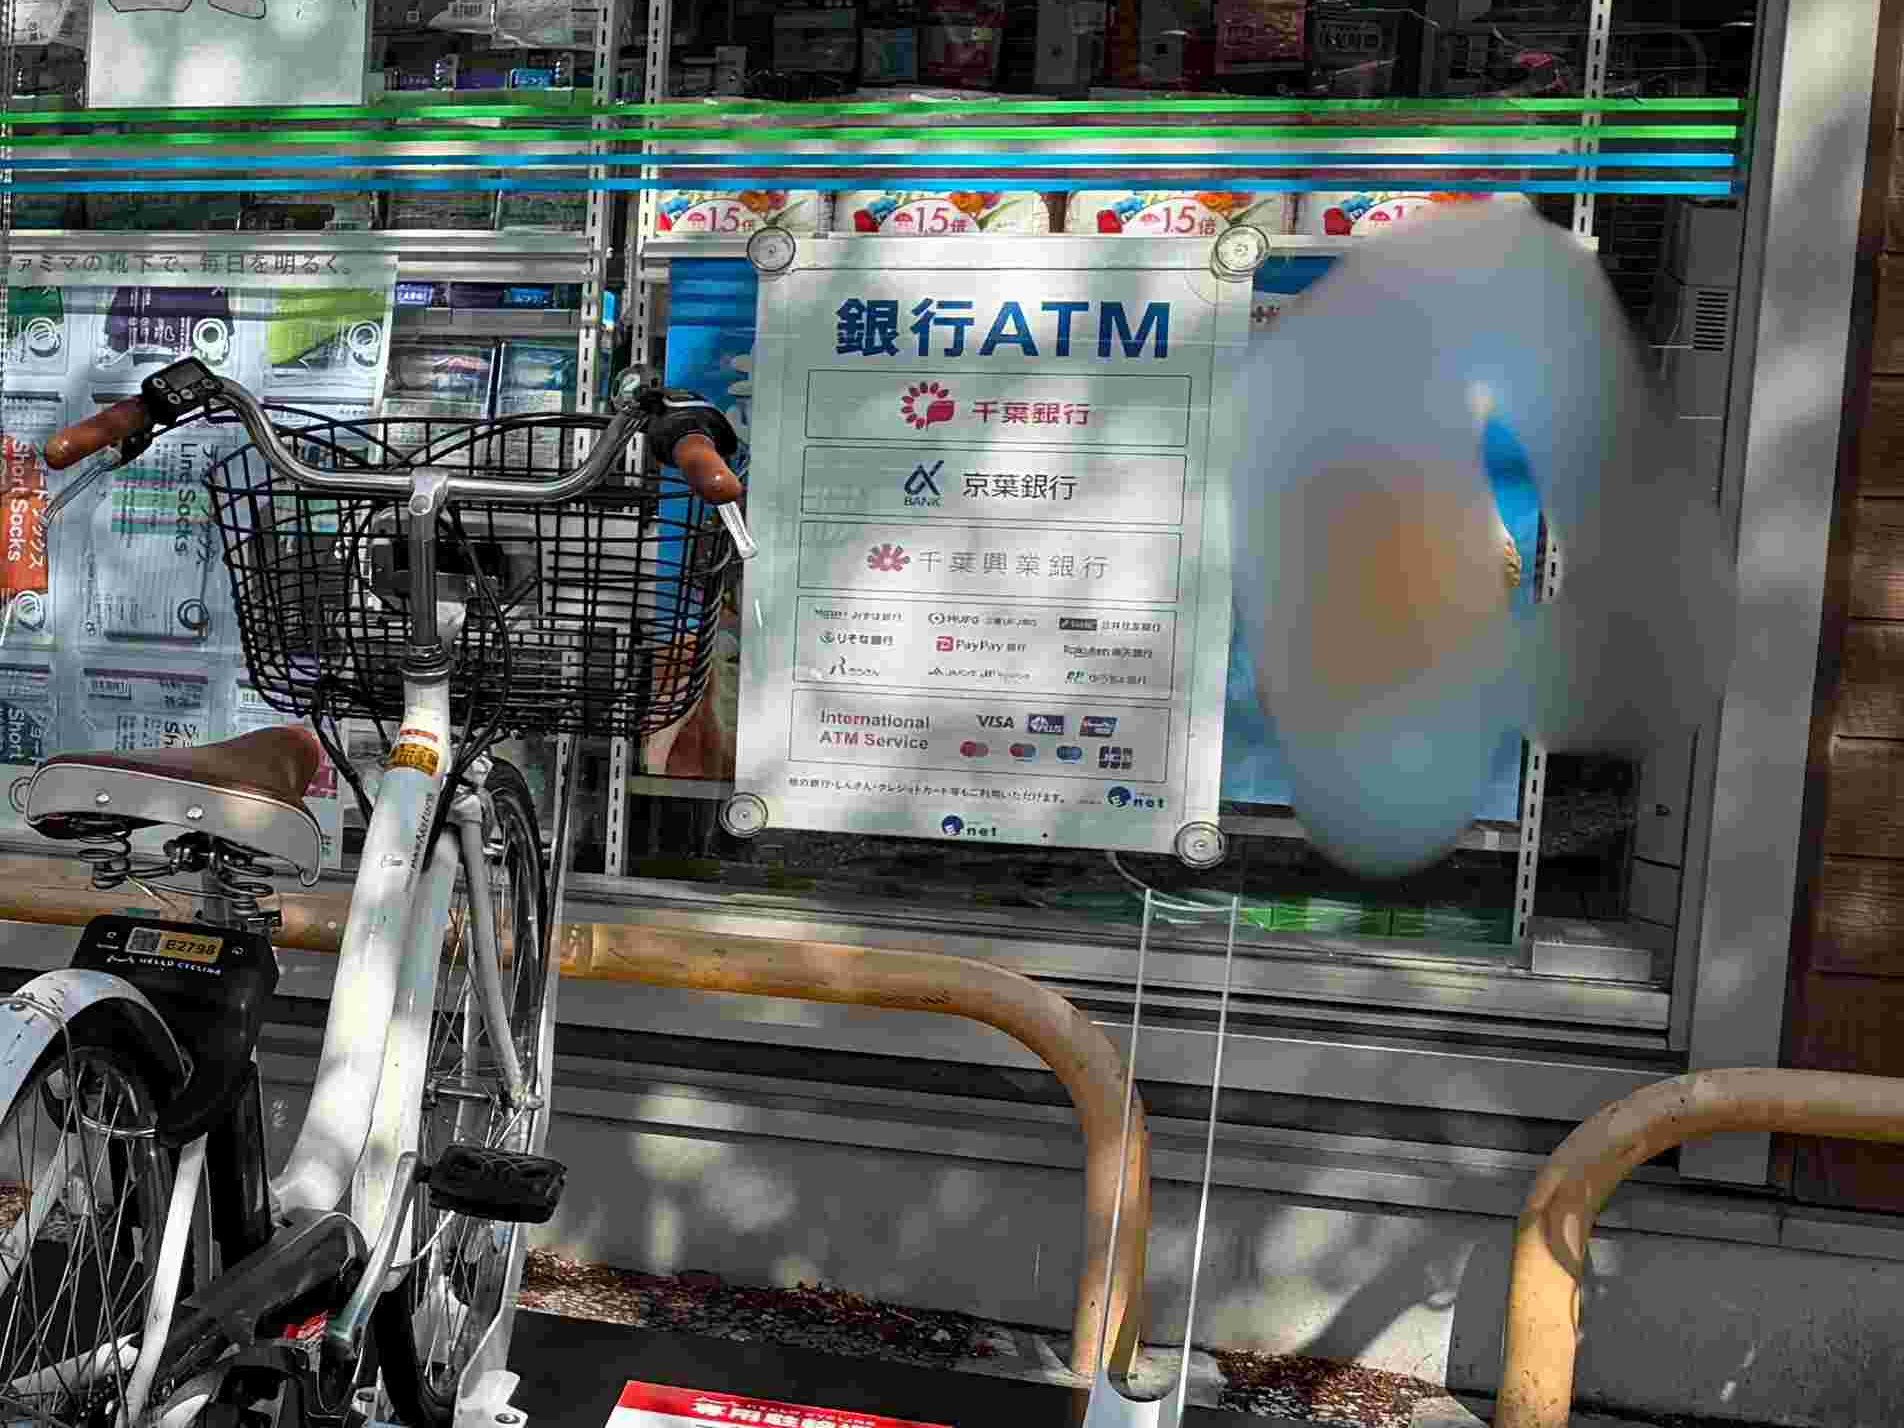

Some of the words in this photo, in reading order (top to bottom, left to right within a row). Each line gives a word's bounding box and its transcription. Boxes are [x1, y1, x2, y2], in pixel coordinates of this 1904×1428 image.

[835, 297, 1171, 358] 銀行ATM
[972, 399, 1091, 426] 千葉銀行
[962, 472, 1079, 501] 京葉銀行
[7, 498, 29, 562] Socks
[920, 549, 1109, 580] 千葉興業銀行
[820, 711, 930, 731] International
[976, 714, 1015, 730] VISA
[819, 732, 859, 747] ATM
[863, 732, 929, 751] Service
